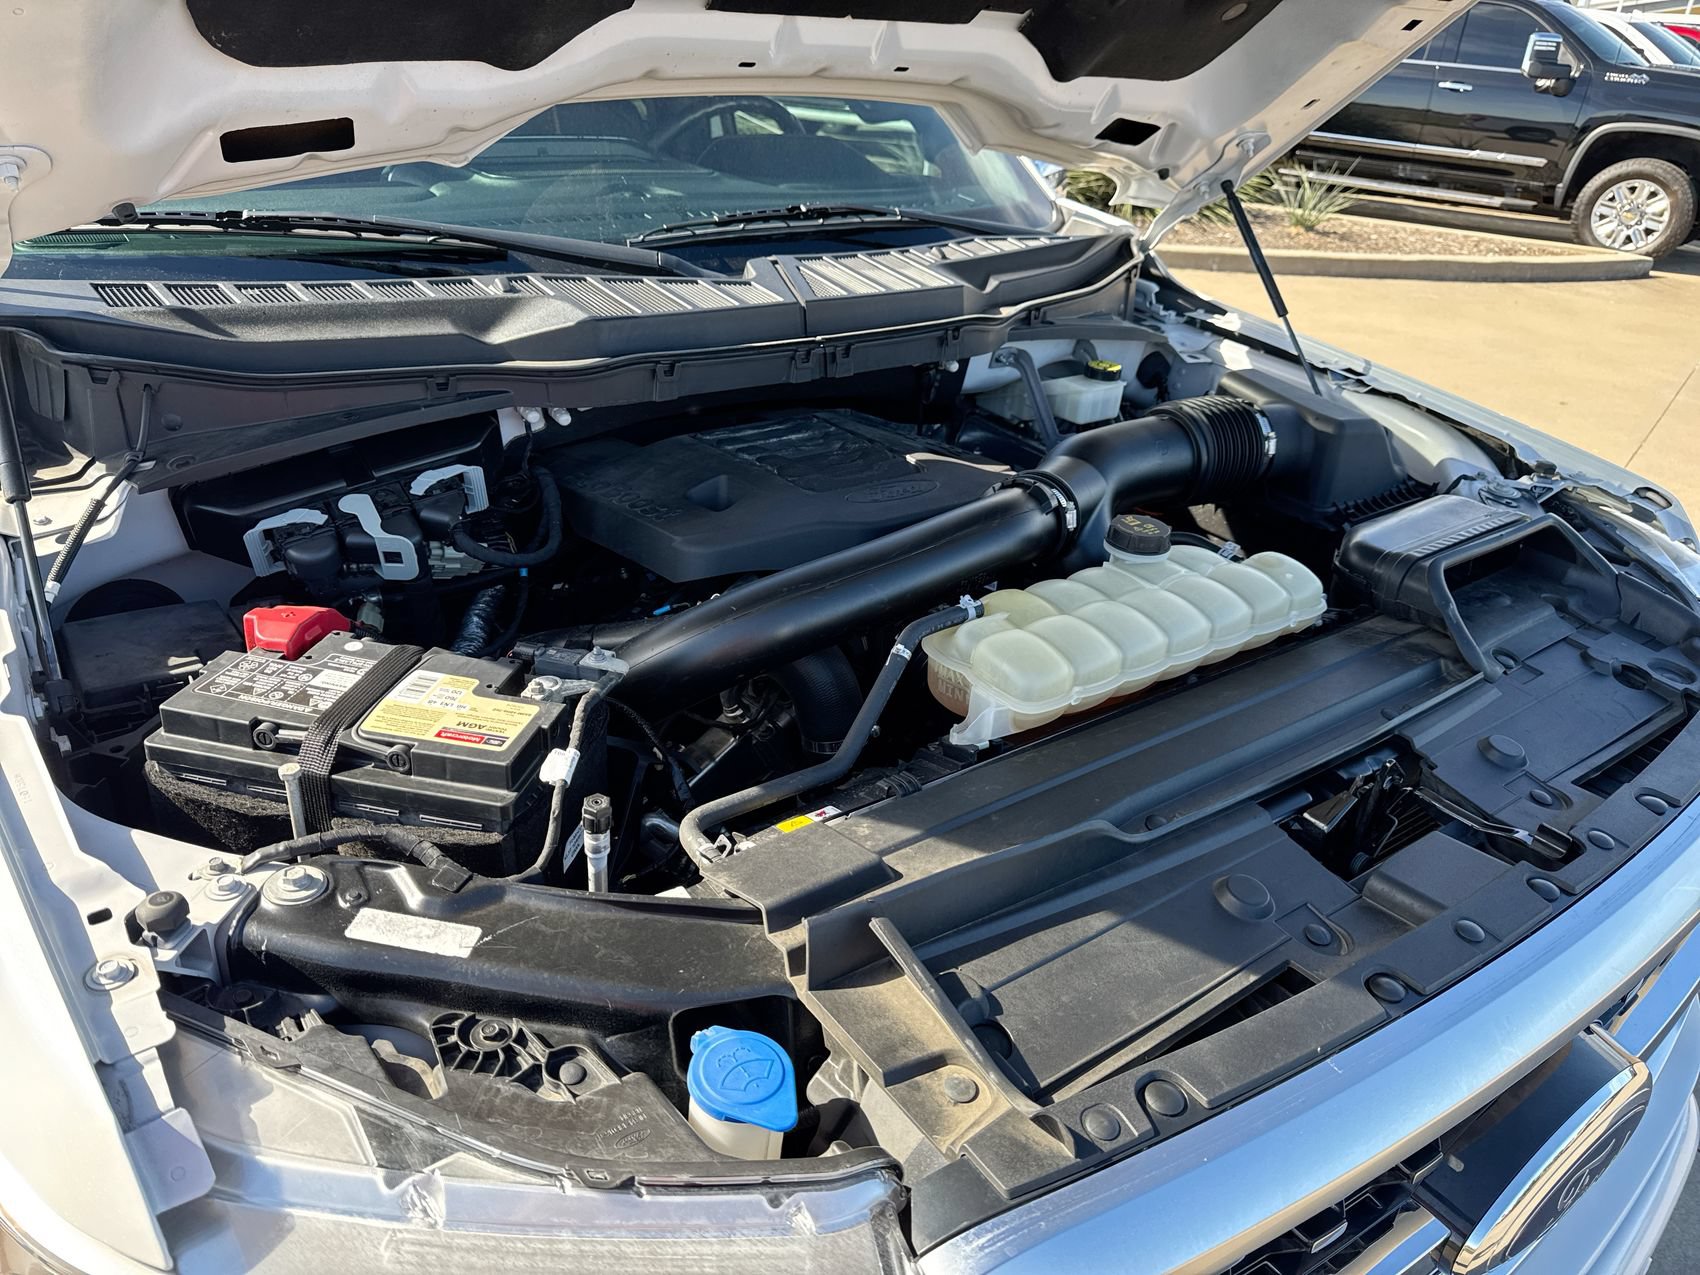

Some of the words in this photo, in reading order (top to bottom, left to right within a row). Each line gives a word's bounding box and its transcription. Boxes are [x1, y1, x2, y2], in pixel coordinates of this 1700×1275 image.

[934, 664, 964, 687] MAX
[938, 679, 964, 701] MIN
[456, 720, 487, 730] AGM
[440, 731, 481, 742] Motorcraft
